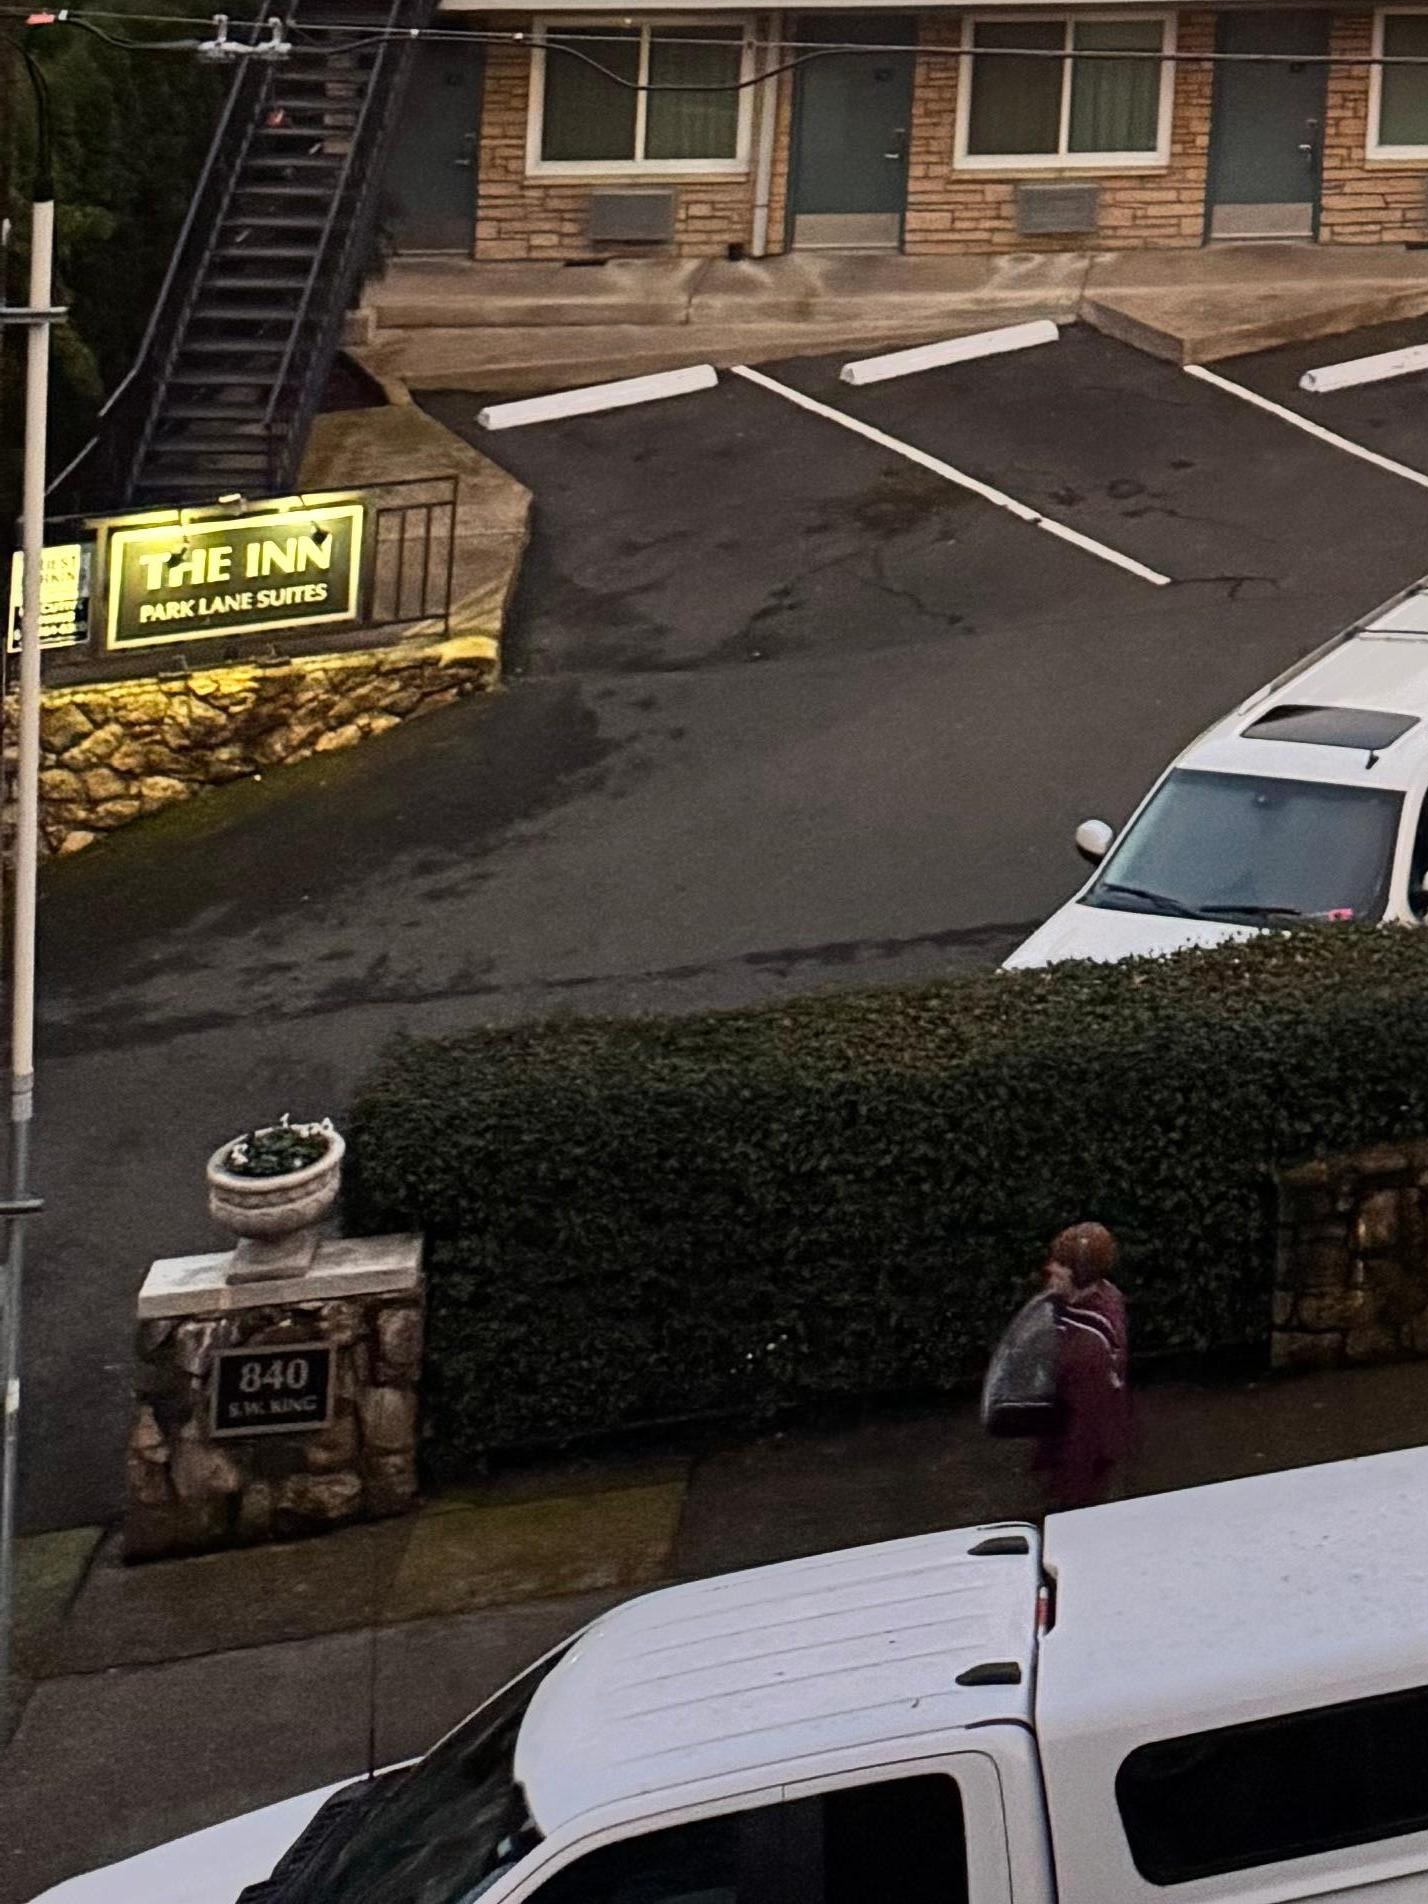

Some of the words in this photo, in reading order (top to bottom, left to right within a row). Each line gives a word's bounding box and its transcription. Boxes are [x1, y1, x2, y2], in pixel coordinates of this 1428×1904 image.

[139, 546, 232, 590] THE
[246, 534, 333, 576] INN
[140, 598, 196, 623] PARK
[198, 592, 254, 616] LANE
[257, 583, 328, 609] SUITES
[239, 1358, 308, 1392] 840
[270, 1395, 317, 1413] KING
